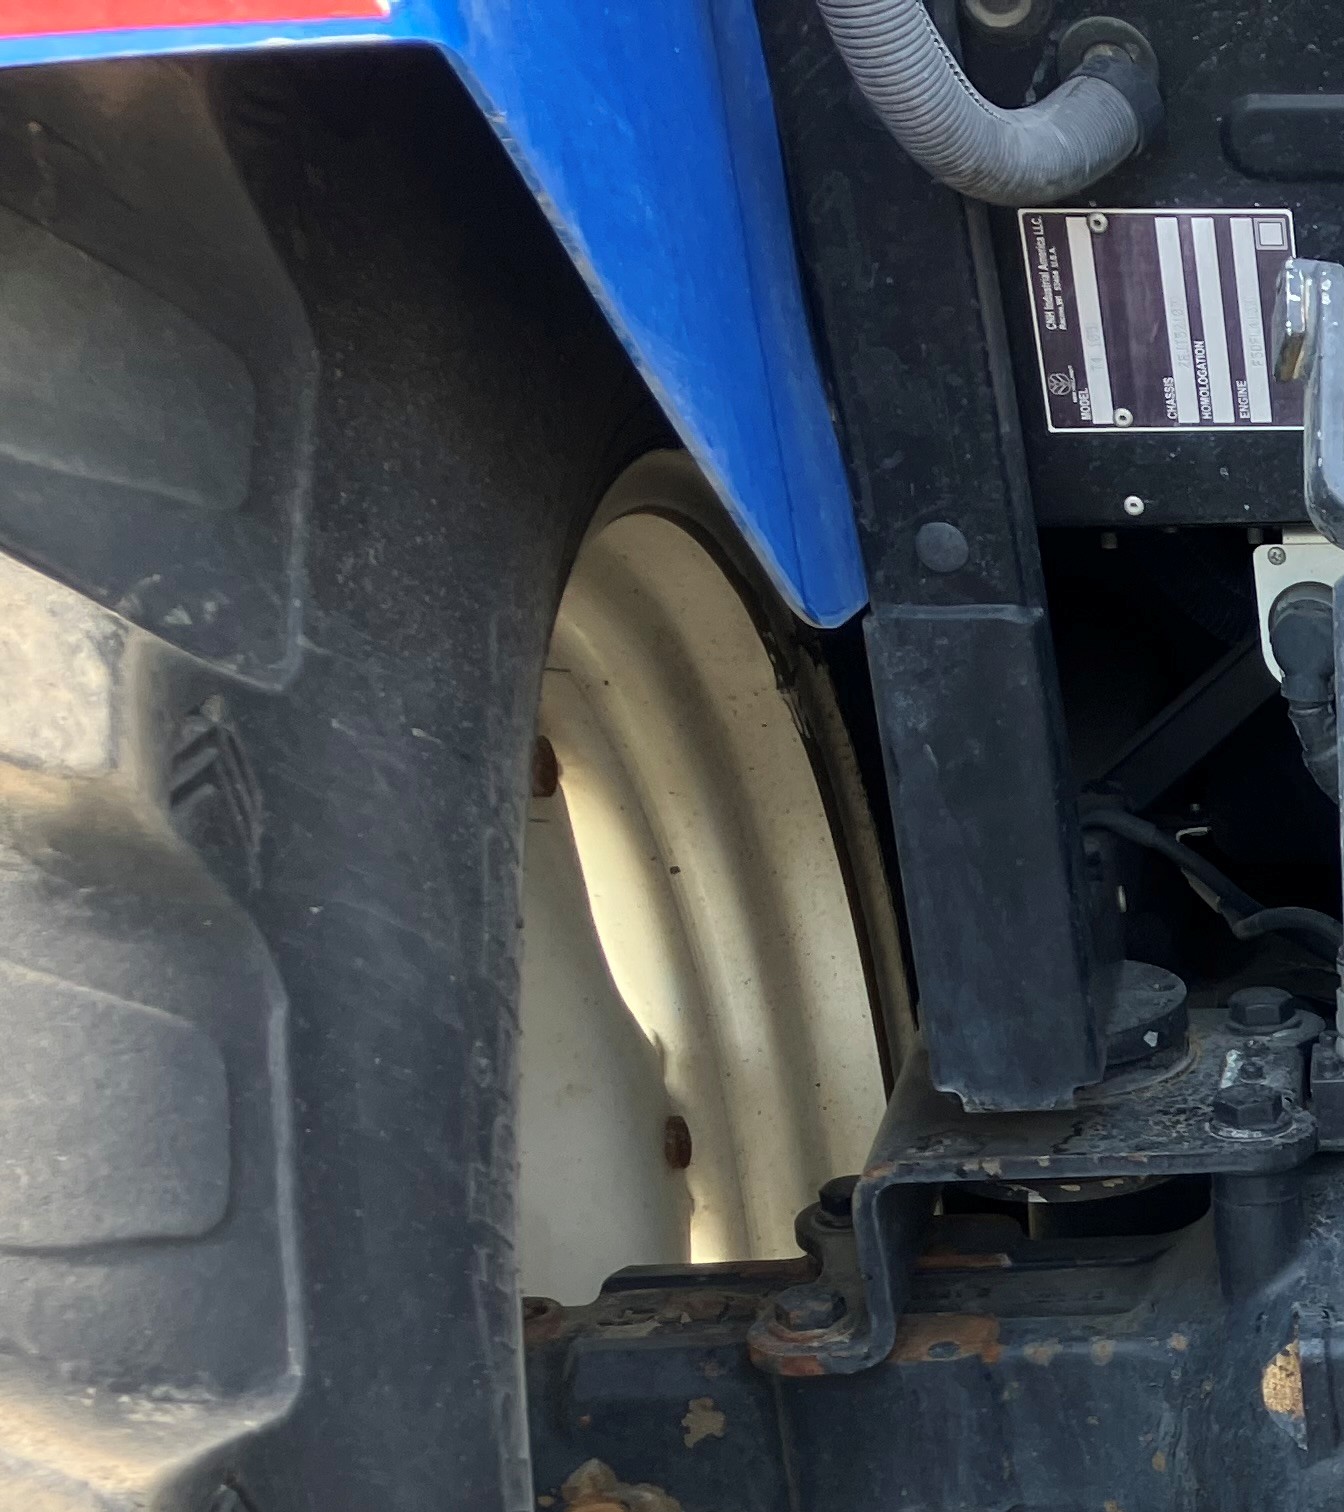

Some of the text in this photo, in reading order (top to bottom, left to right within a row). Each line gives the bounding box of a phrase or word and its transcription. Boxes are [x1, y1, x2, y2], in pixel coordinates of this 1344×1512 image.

[1035, 236, 1048, 271] America
[1039, 271, 1054, 310] Industrial
[1166, 377, 1178, 420] CHASSIS
[1194, 339, 1213, 420] HOMOLOGATION
[1238, 379, 1250, 419] ENGINE
[1079, 387, 1092, 421] MODEL
